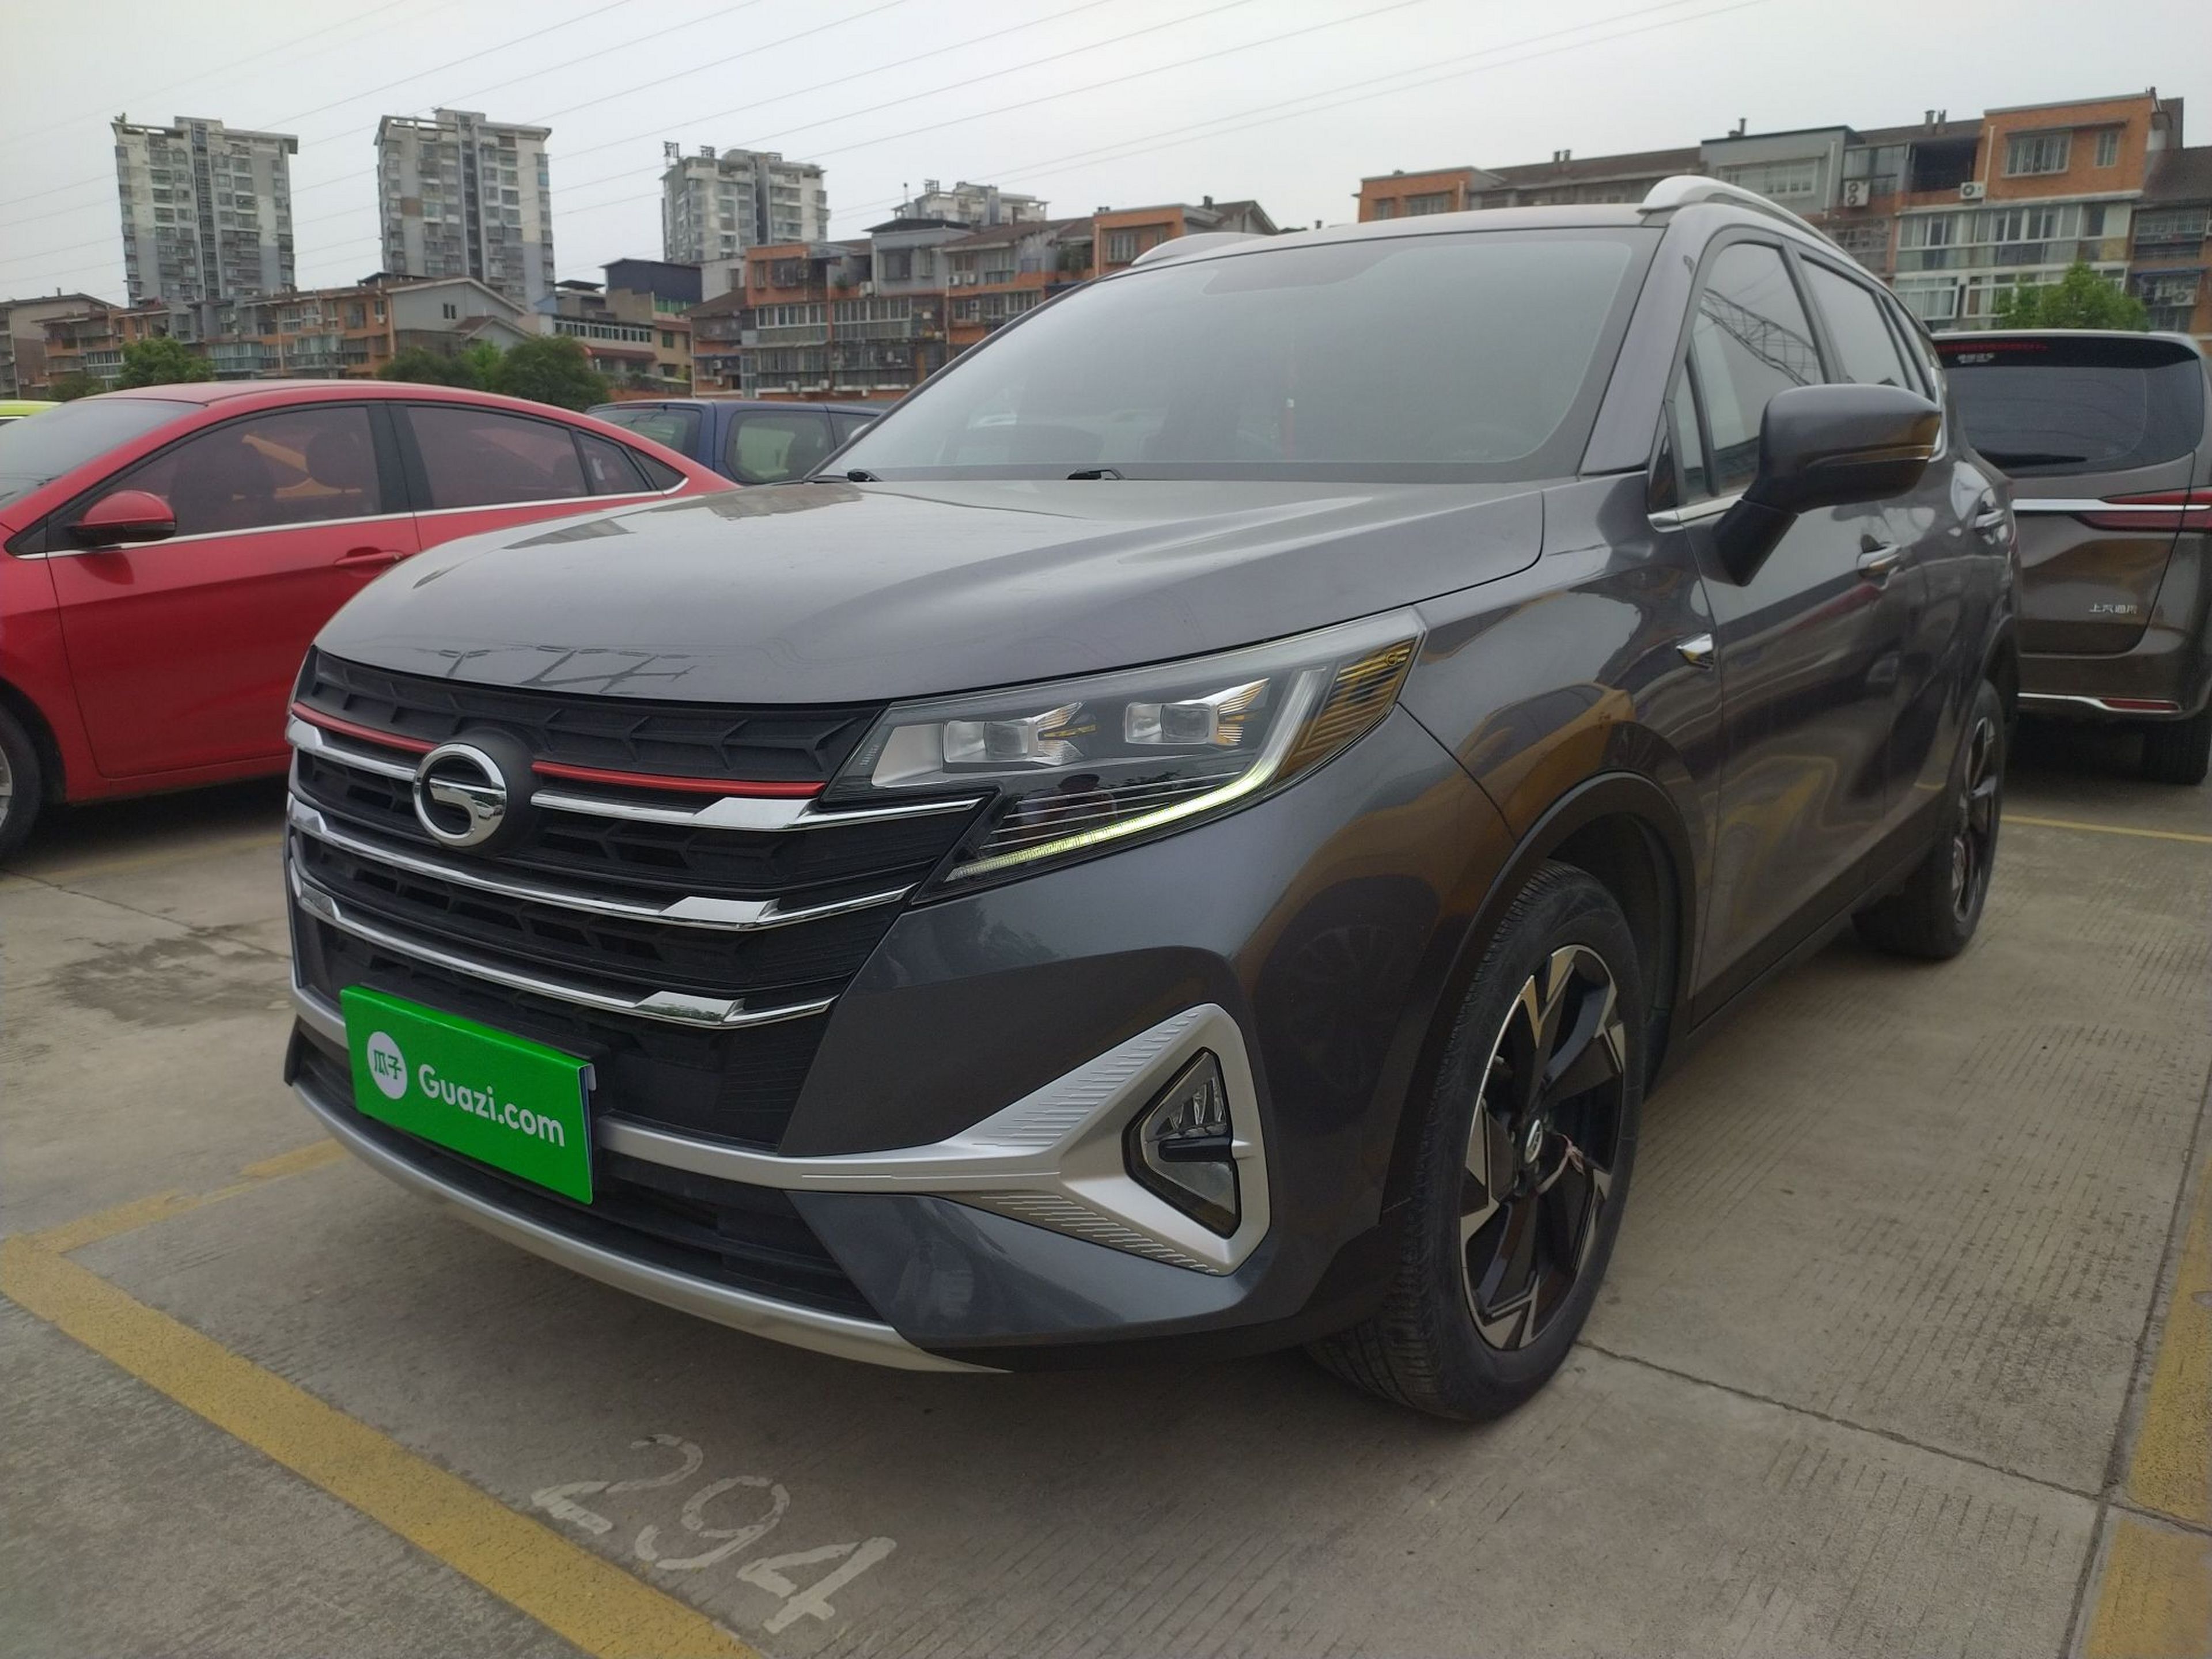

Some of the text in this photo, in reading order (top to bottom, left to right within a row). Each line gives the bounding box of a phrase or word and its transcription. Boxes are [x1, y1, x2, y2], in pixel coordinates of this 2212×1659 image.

[373, 1049, 403, 1080] 瓜子
[418, 1063, 565, 1147] Guazi.com
[531, 1433, 897, 1634] 294
